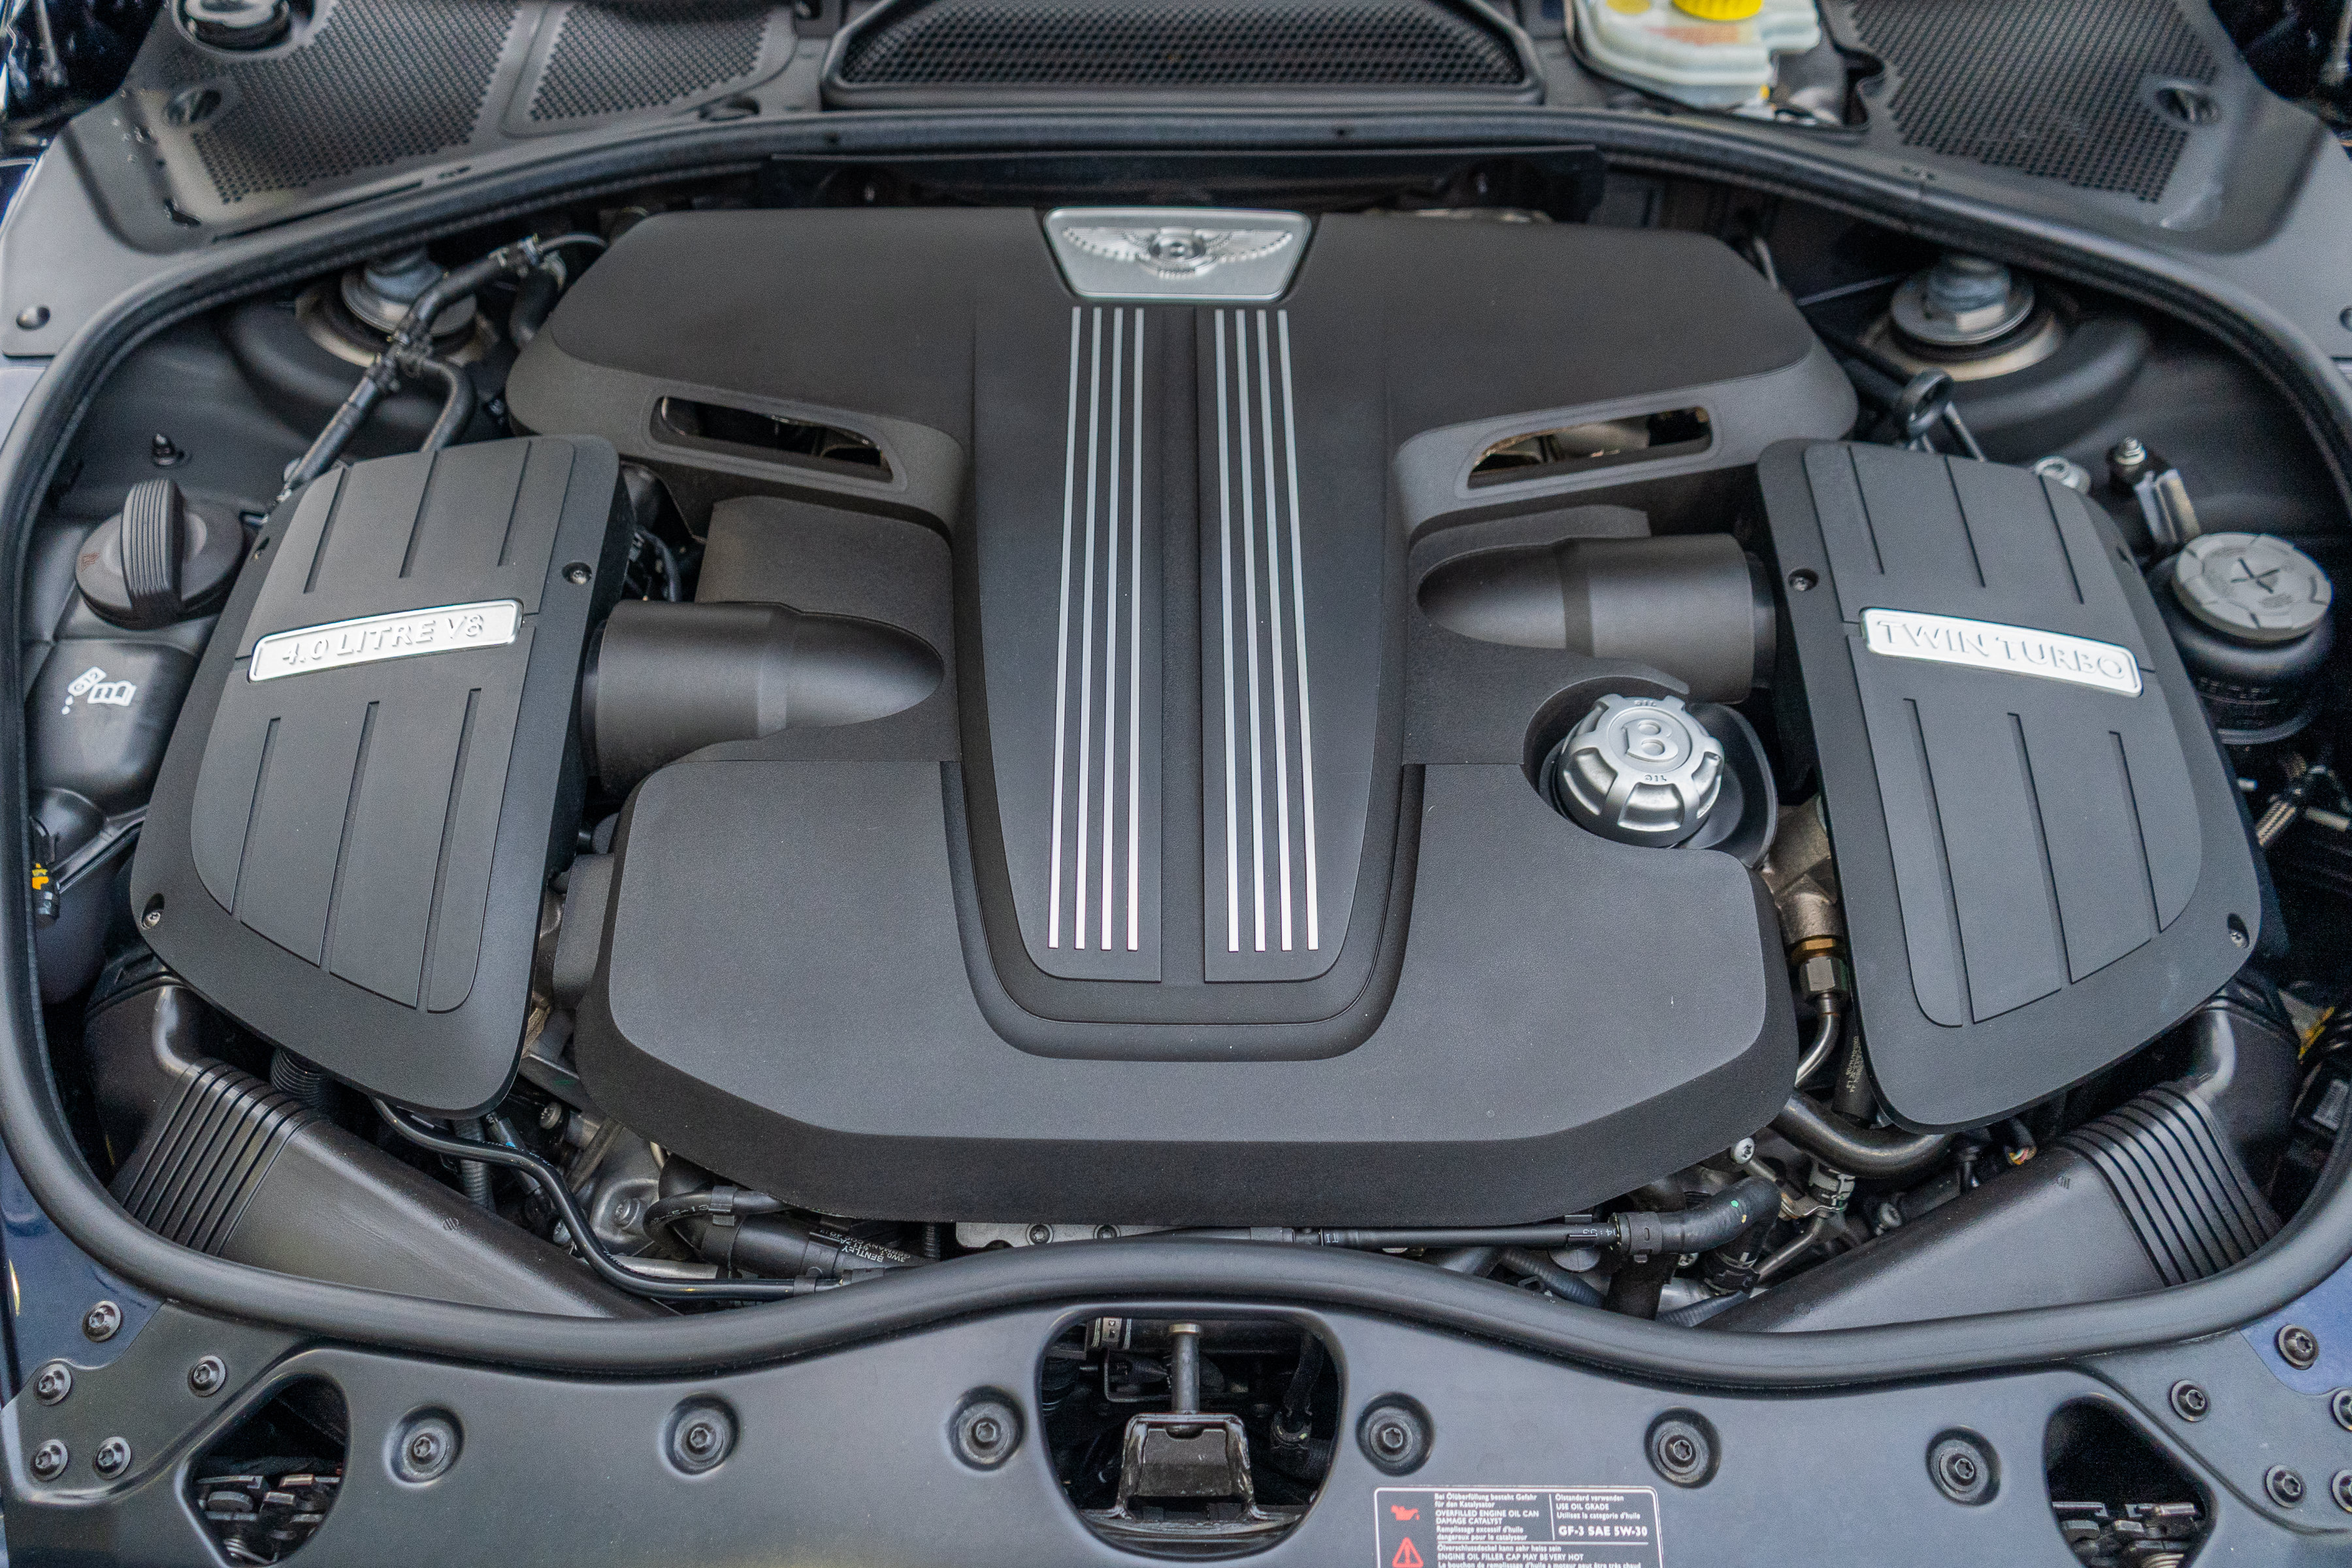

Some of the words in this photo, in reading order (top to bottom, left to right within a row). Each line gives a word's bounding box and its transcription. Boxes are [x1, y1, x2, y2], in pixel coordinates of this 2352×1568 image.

[282, 638, 329, 664] 4.0
[336, 621, 437, 656] LITRE
[445, 614, 484, 639] V8
[1877, 621, 1989, 657] TWIN
[1995, 636, 2125, 679] TURBO
[841, 1245, 884, 1263] BENTLEY
[1446, 1492, 1490, 1501] Ölüberfüllung
[1437, 1525, 1474, 1534] Remplissage
[1558, 1526, 1584, 1536] GF-3
[1588, 1526, 1610, 1536] SAE
[1614, 1526, 1648, 1536] 5W-30
